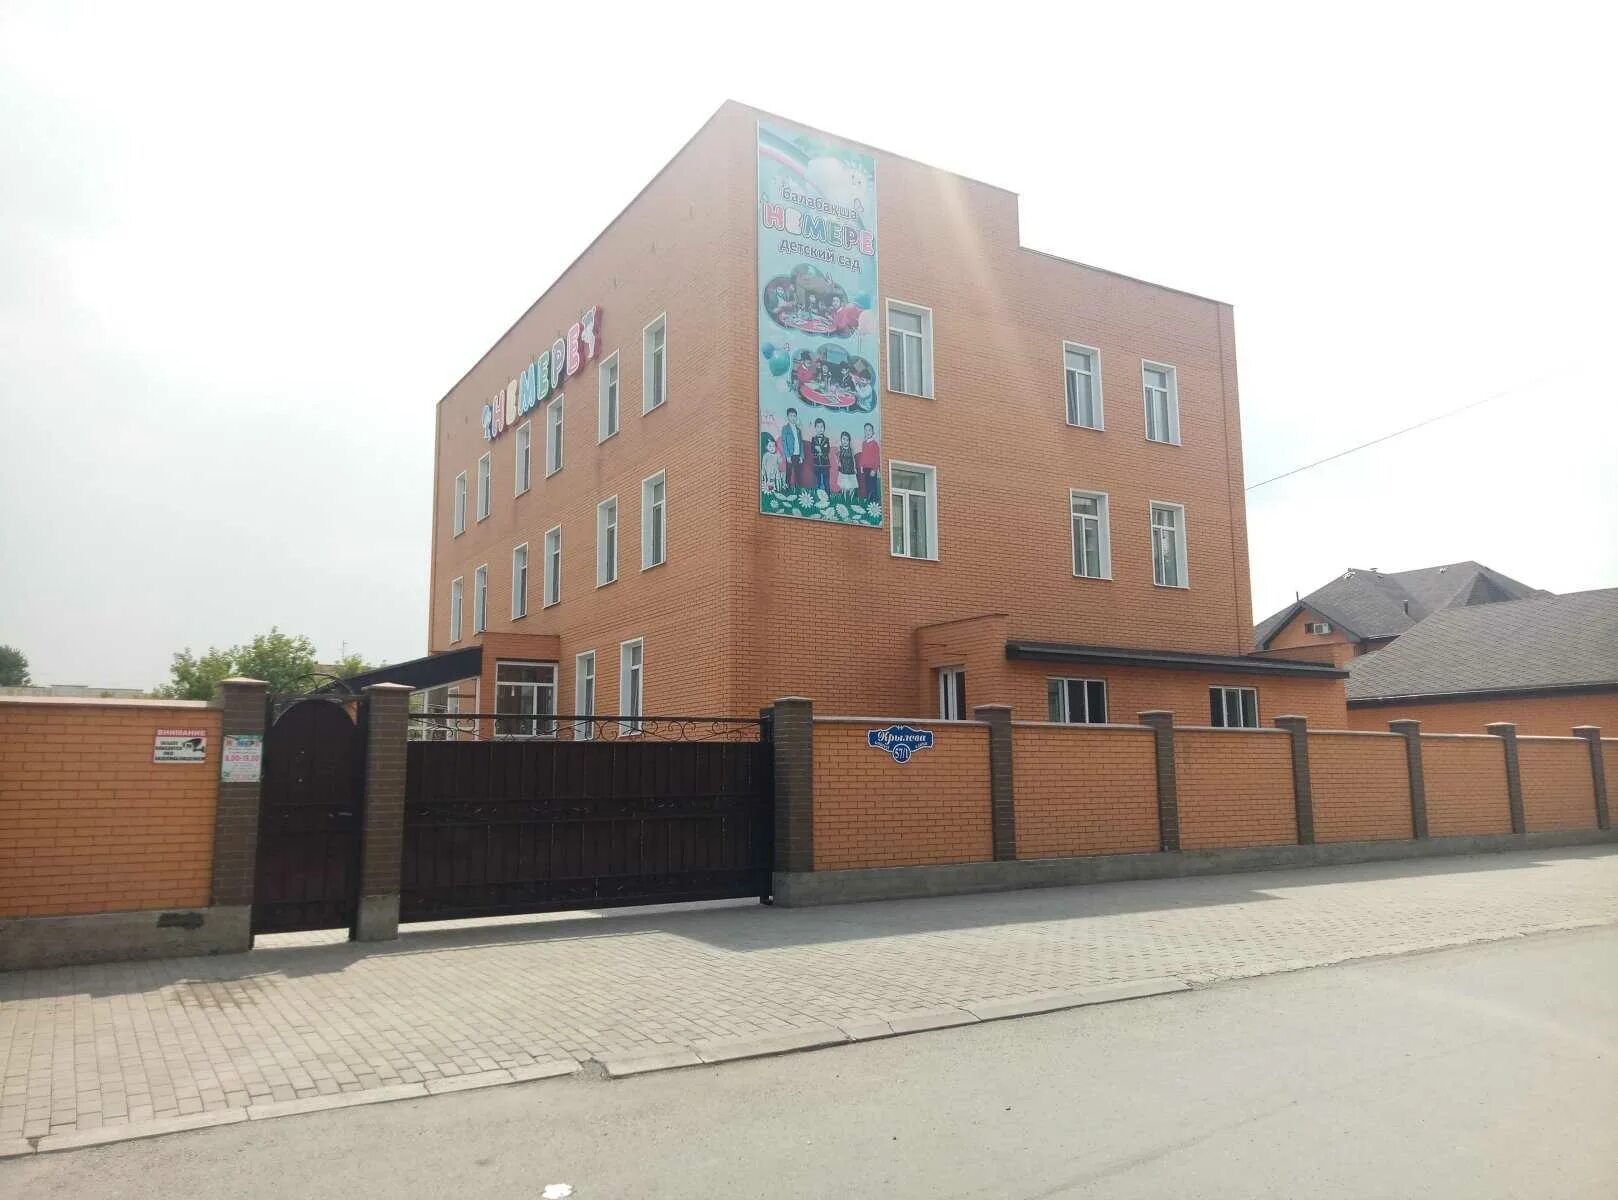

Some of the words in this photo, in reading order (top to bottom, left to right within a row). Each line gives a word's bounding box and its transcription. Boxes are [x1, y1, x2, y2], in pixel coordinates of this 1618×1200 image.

[779, 239, 835, 262] детский
[838, 255, 861, 272] сад
[877, 731, 926, 745] Крылова
